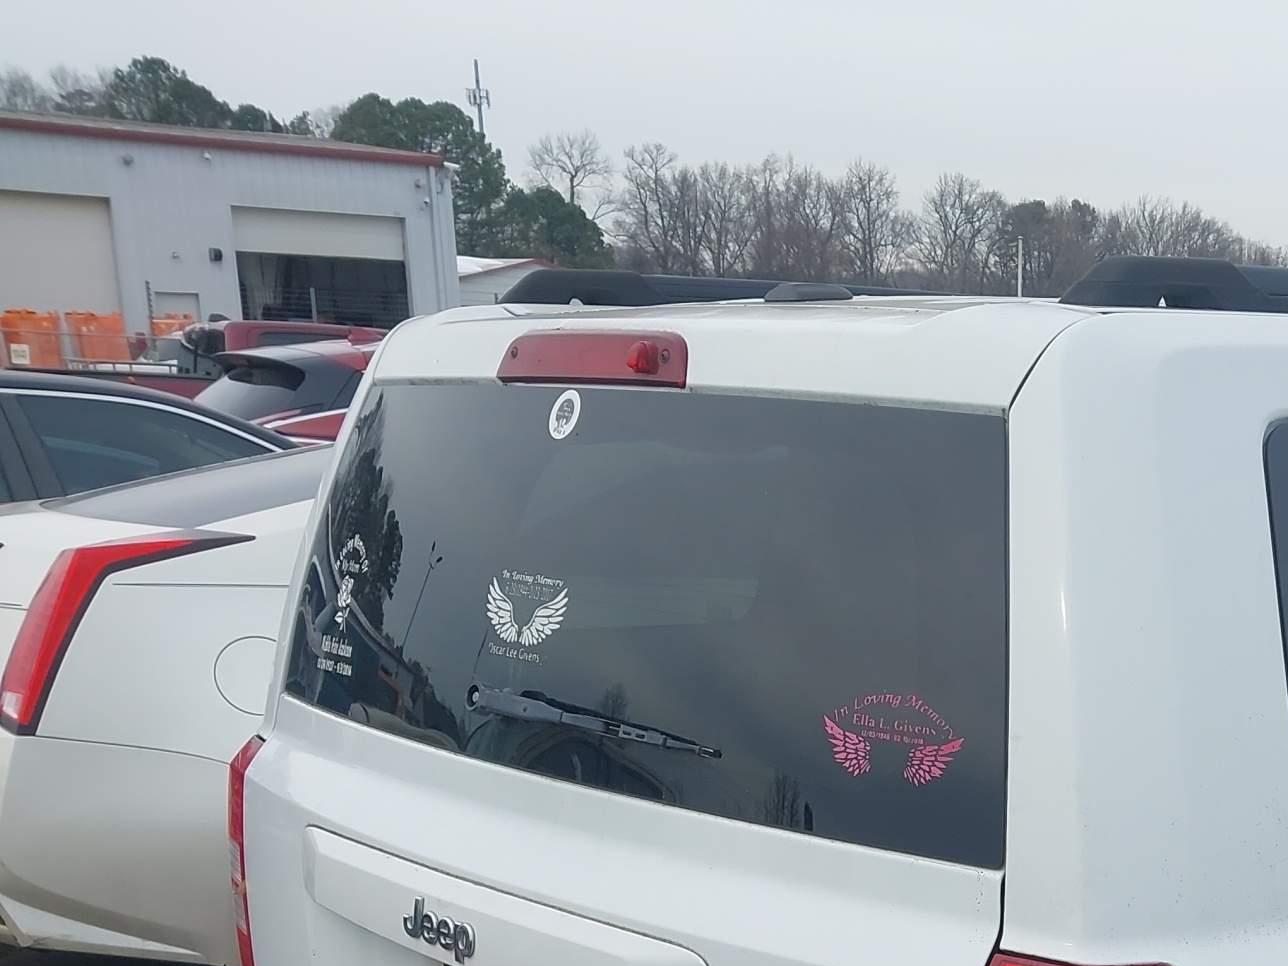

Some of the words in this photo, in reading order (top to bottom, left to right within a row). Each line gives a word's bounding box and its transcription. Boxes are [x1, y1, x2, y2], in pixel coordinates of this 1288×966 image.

[502, 569, 511, 579] In
[511, 571, 534, 585] Loving
[535, 574, 564, 589] Memory
[834, 705, 850, 722] In
[854, 690, 902, 710] Loving
[904, 694, 954, 740] Memory
[852, 713, 876, 728] Ella
[893, 719, 938, 737] Givens
[403, 896, 476, 966] Jeep
